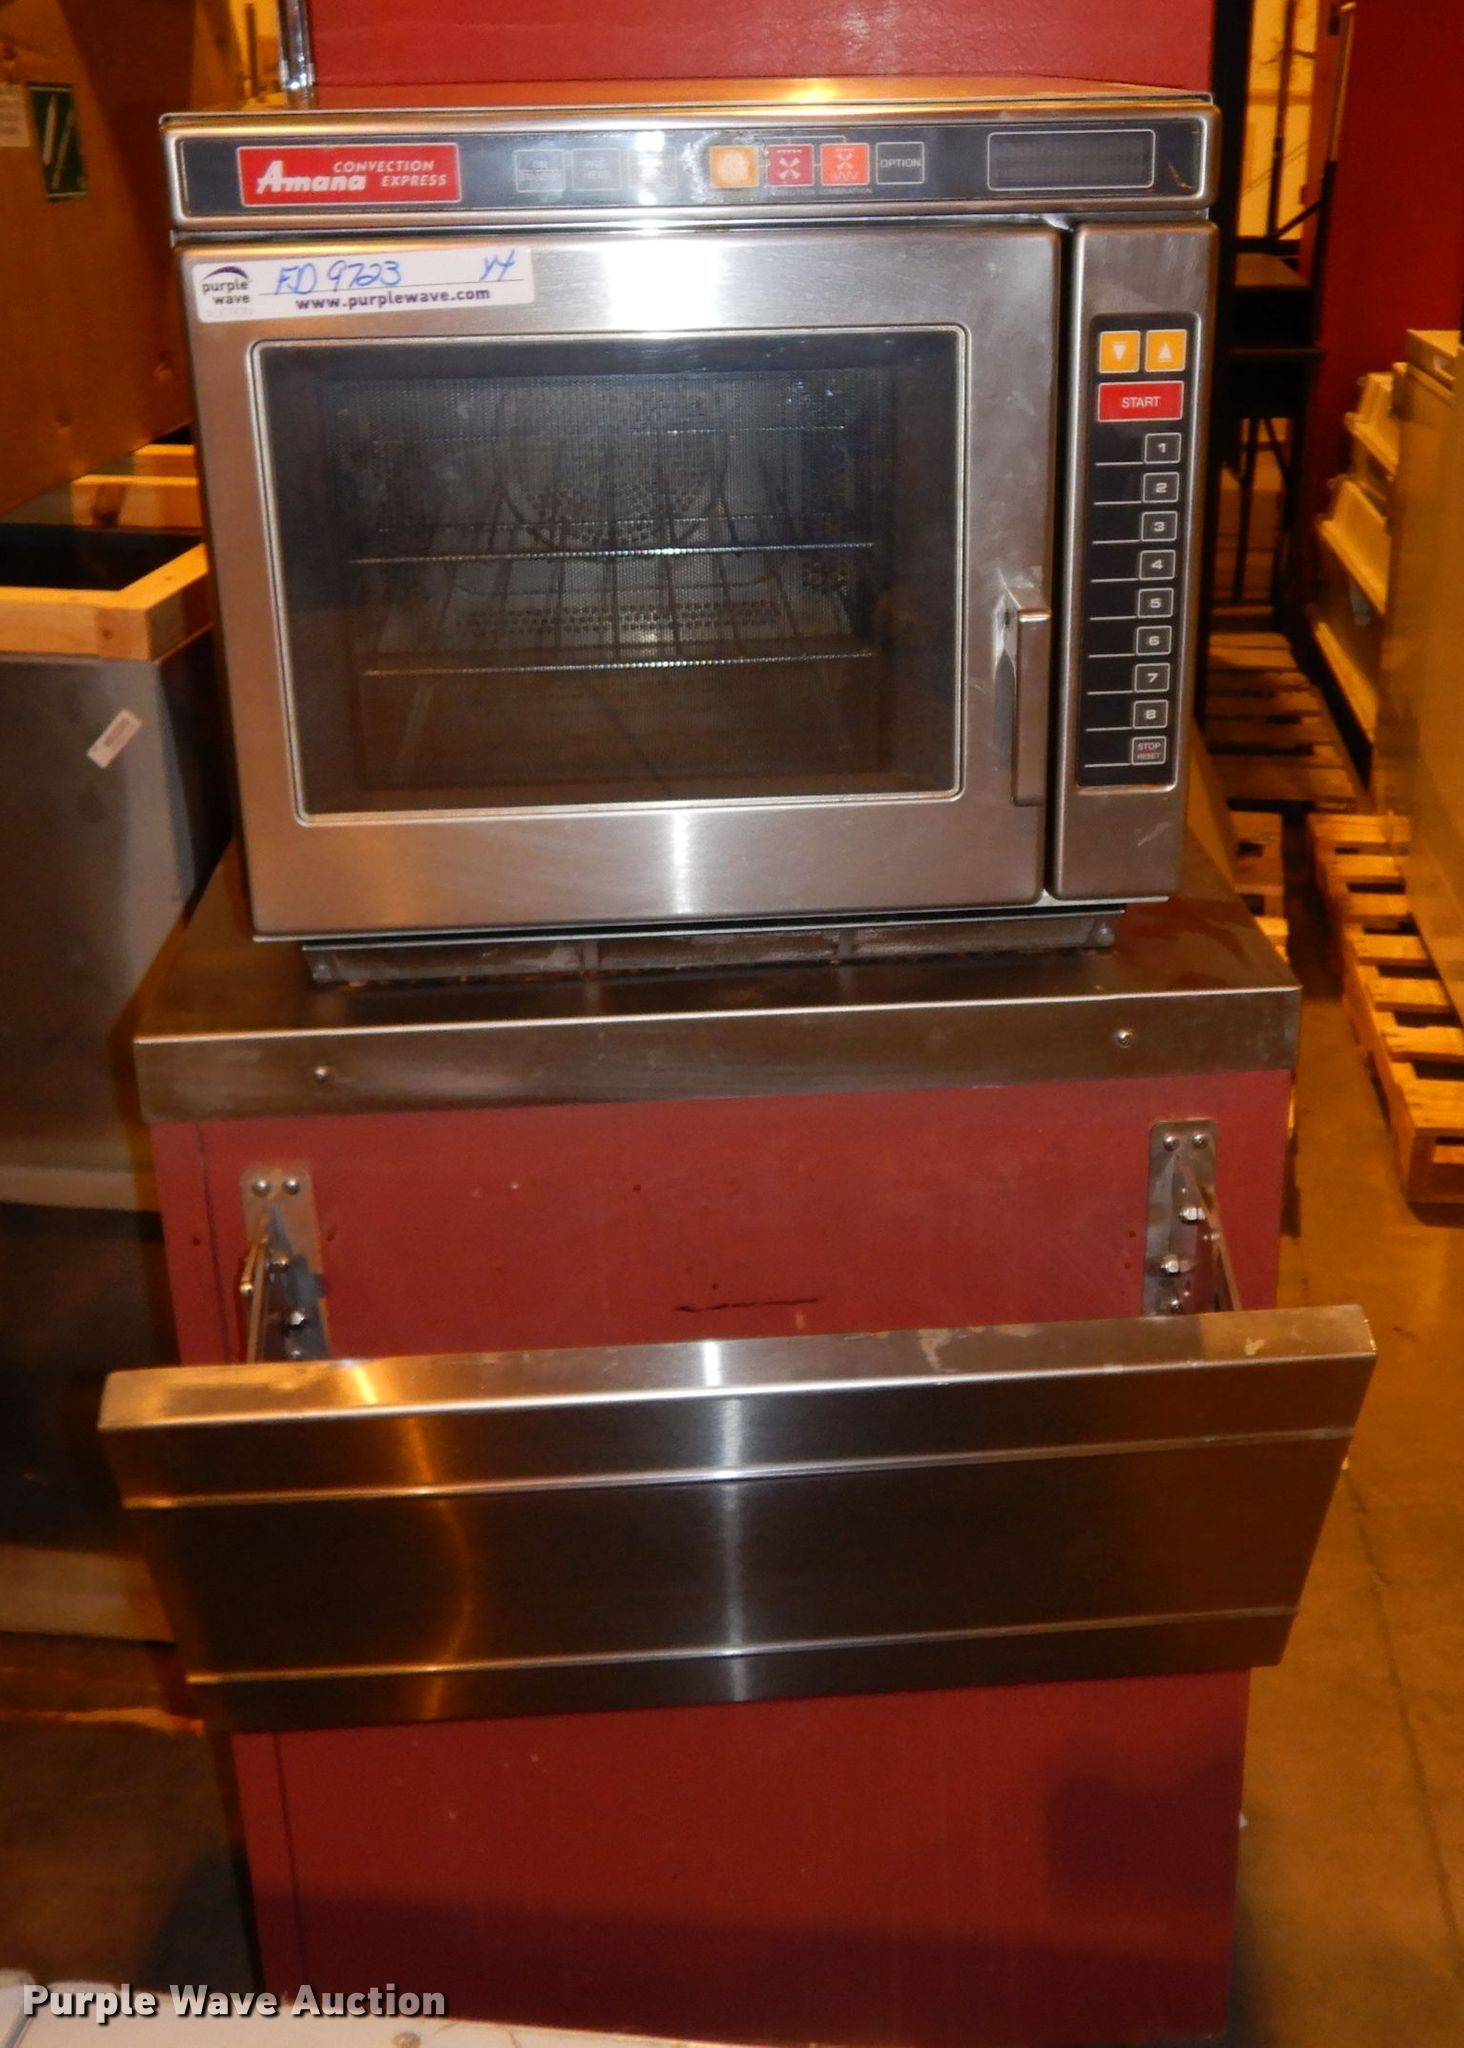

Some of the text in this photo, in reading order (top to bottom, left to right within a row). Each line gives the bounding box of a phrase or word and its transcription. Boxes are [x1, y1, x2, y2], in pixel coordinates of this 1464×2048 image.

[333, 159, 435, 173] CONVECTION
[879, 158, 922, 169] OPTION
[256, 160, 448, 195] Amana EXPRESS
[202, 279, 249, 294] purple
[212, 294, 251, 305] wave
[295, 287, 491, 311] www.purplewave.com
[1121, 396, 1160, 409] START
[1157, 442, 1167, 453] 1
[1155, 482, 1168, 493] 2
[1153, 521, 1165, 532] 3
[1151, 559, 1163, 569] 4
[1150, 598, 1161, 608] 5
[1148, 635, 1160, 646] 6
[1147, 673, 1158, 683] 7
[1145, 709, 1156, 719] 8
[1137, 742, 1161, 751] STOP
